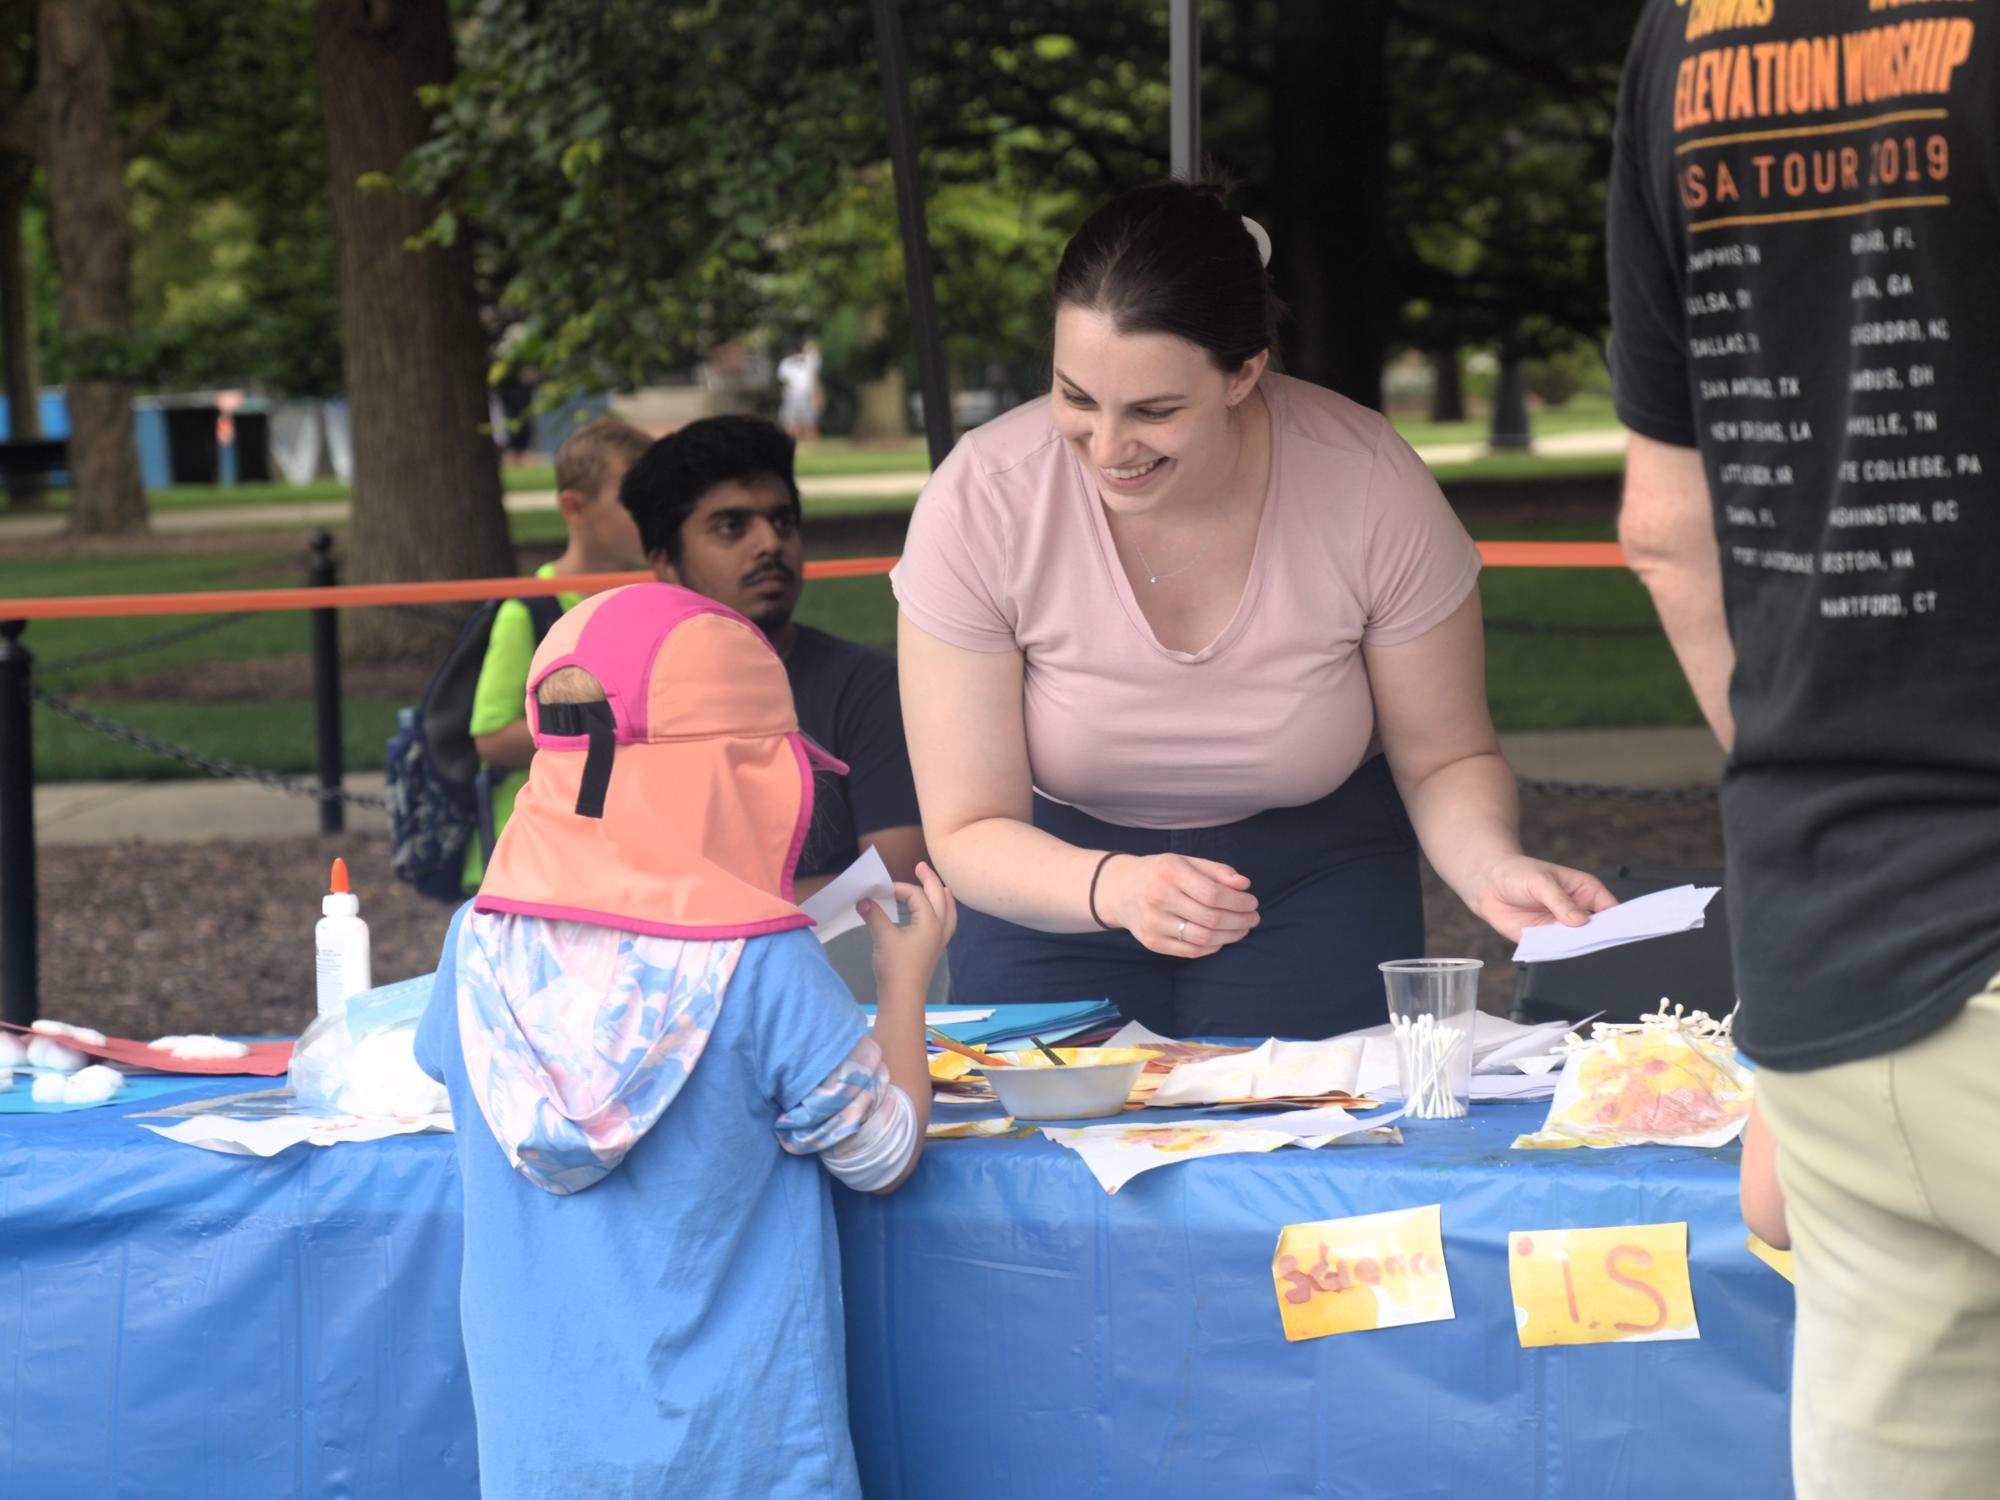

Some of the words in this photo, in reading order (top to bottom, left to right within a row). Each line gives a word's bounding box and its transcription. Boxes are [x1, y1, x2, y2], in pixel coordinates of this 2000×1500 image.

[1752, 146, 1859, 199] TOUR
[1887, 273, 1913, 296] GA
[1928, 318, 1950, 341] NC
[1789, 421, 1812, 443] LA
[1912, 410, 1938, 431] TN
[1862, 454, 1951, 482] COLLEGE,
[1956, 453, 1982, 475] PA
[1932, 499, 1959, 523] DC
[1912, 590, 1938, 614] CT
